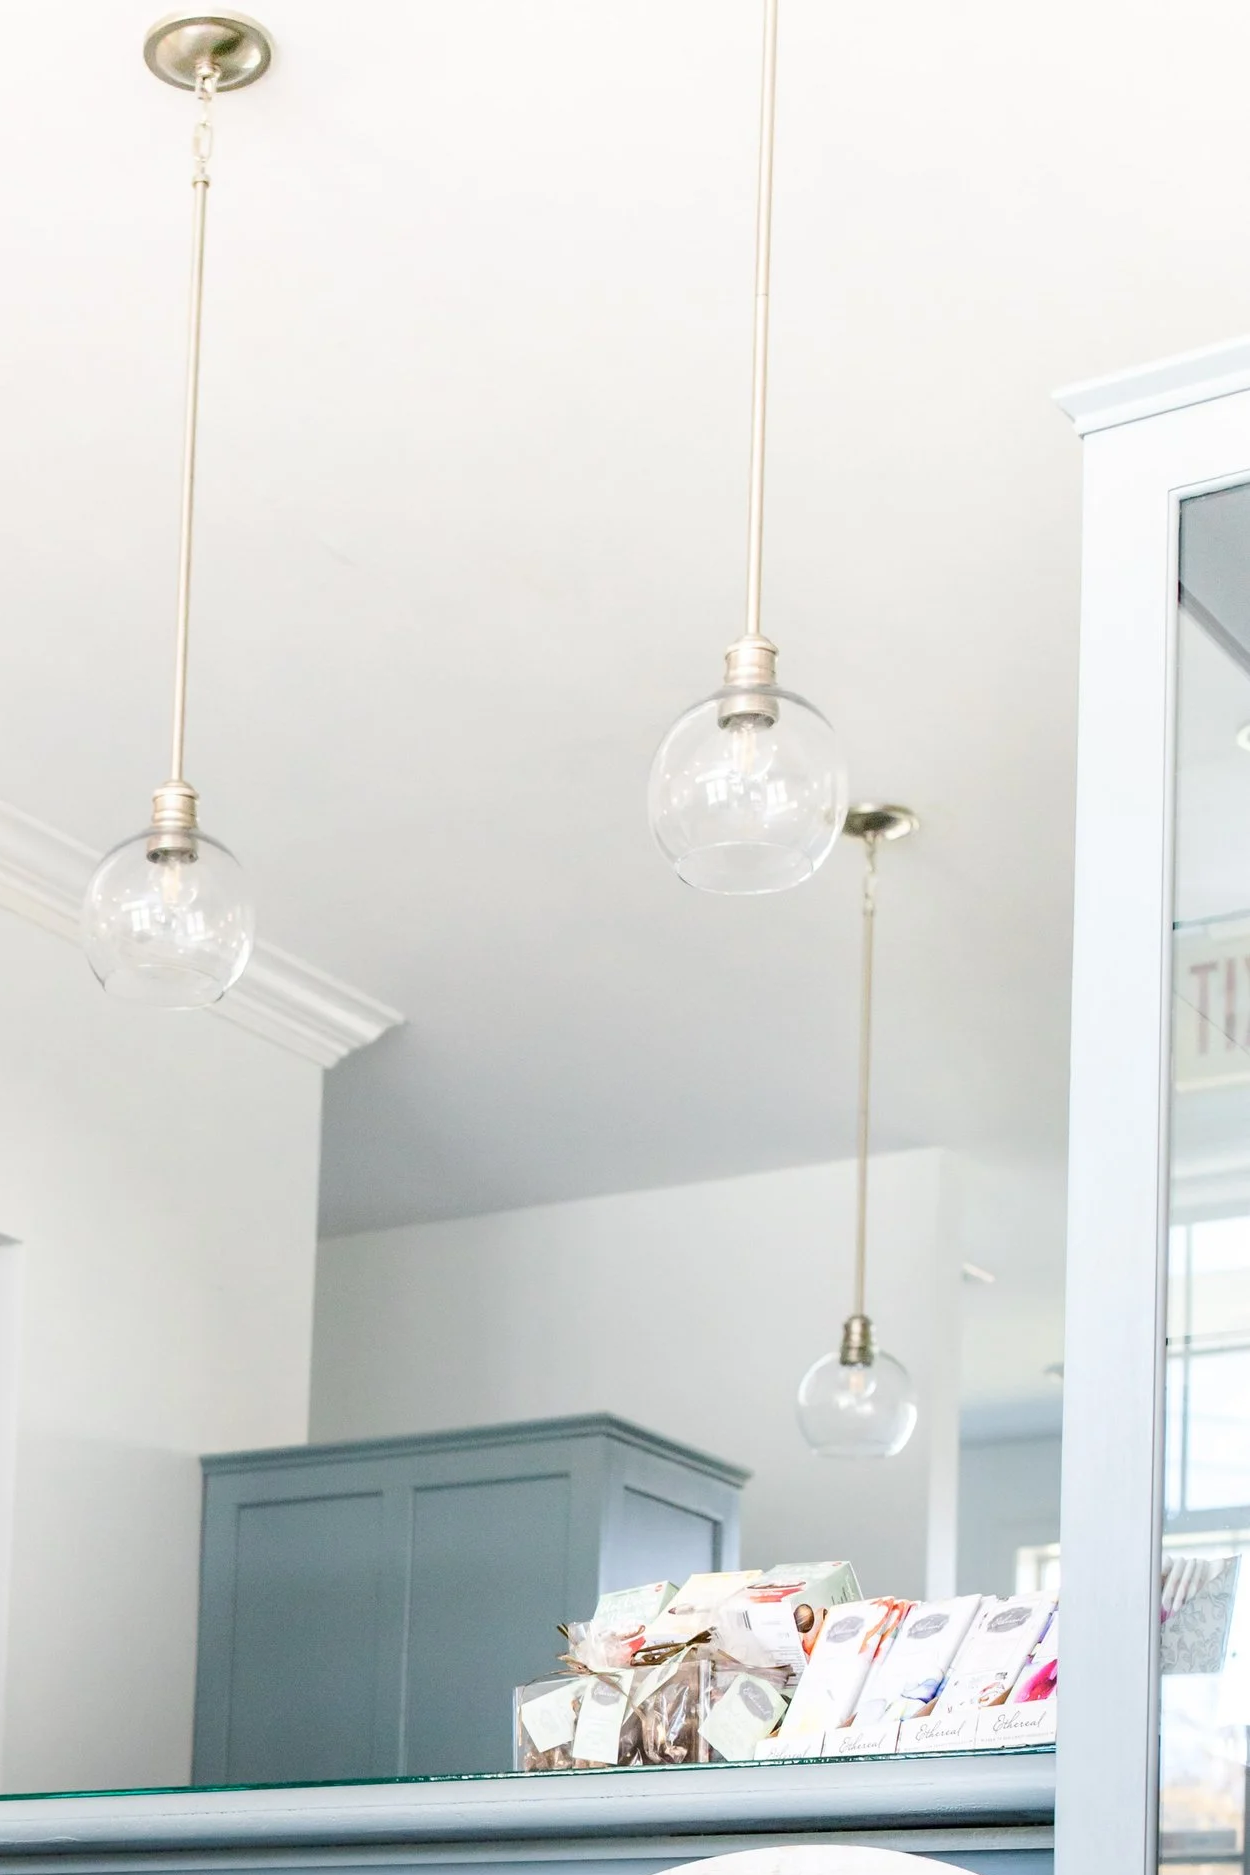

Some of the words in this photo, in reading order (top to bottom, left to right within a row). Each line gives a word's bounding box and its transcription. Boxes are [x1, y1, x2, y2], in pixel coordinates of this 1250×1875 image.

[915, 1720, 966, 1741] Ethereal
[993, 1711, 1047, 1732] Ethereal
[838, 1733, 884, 1753] Ethereal
